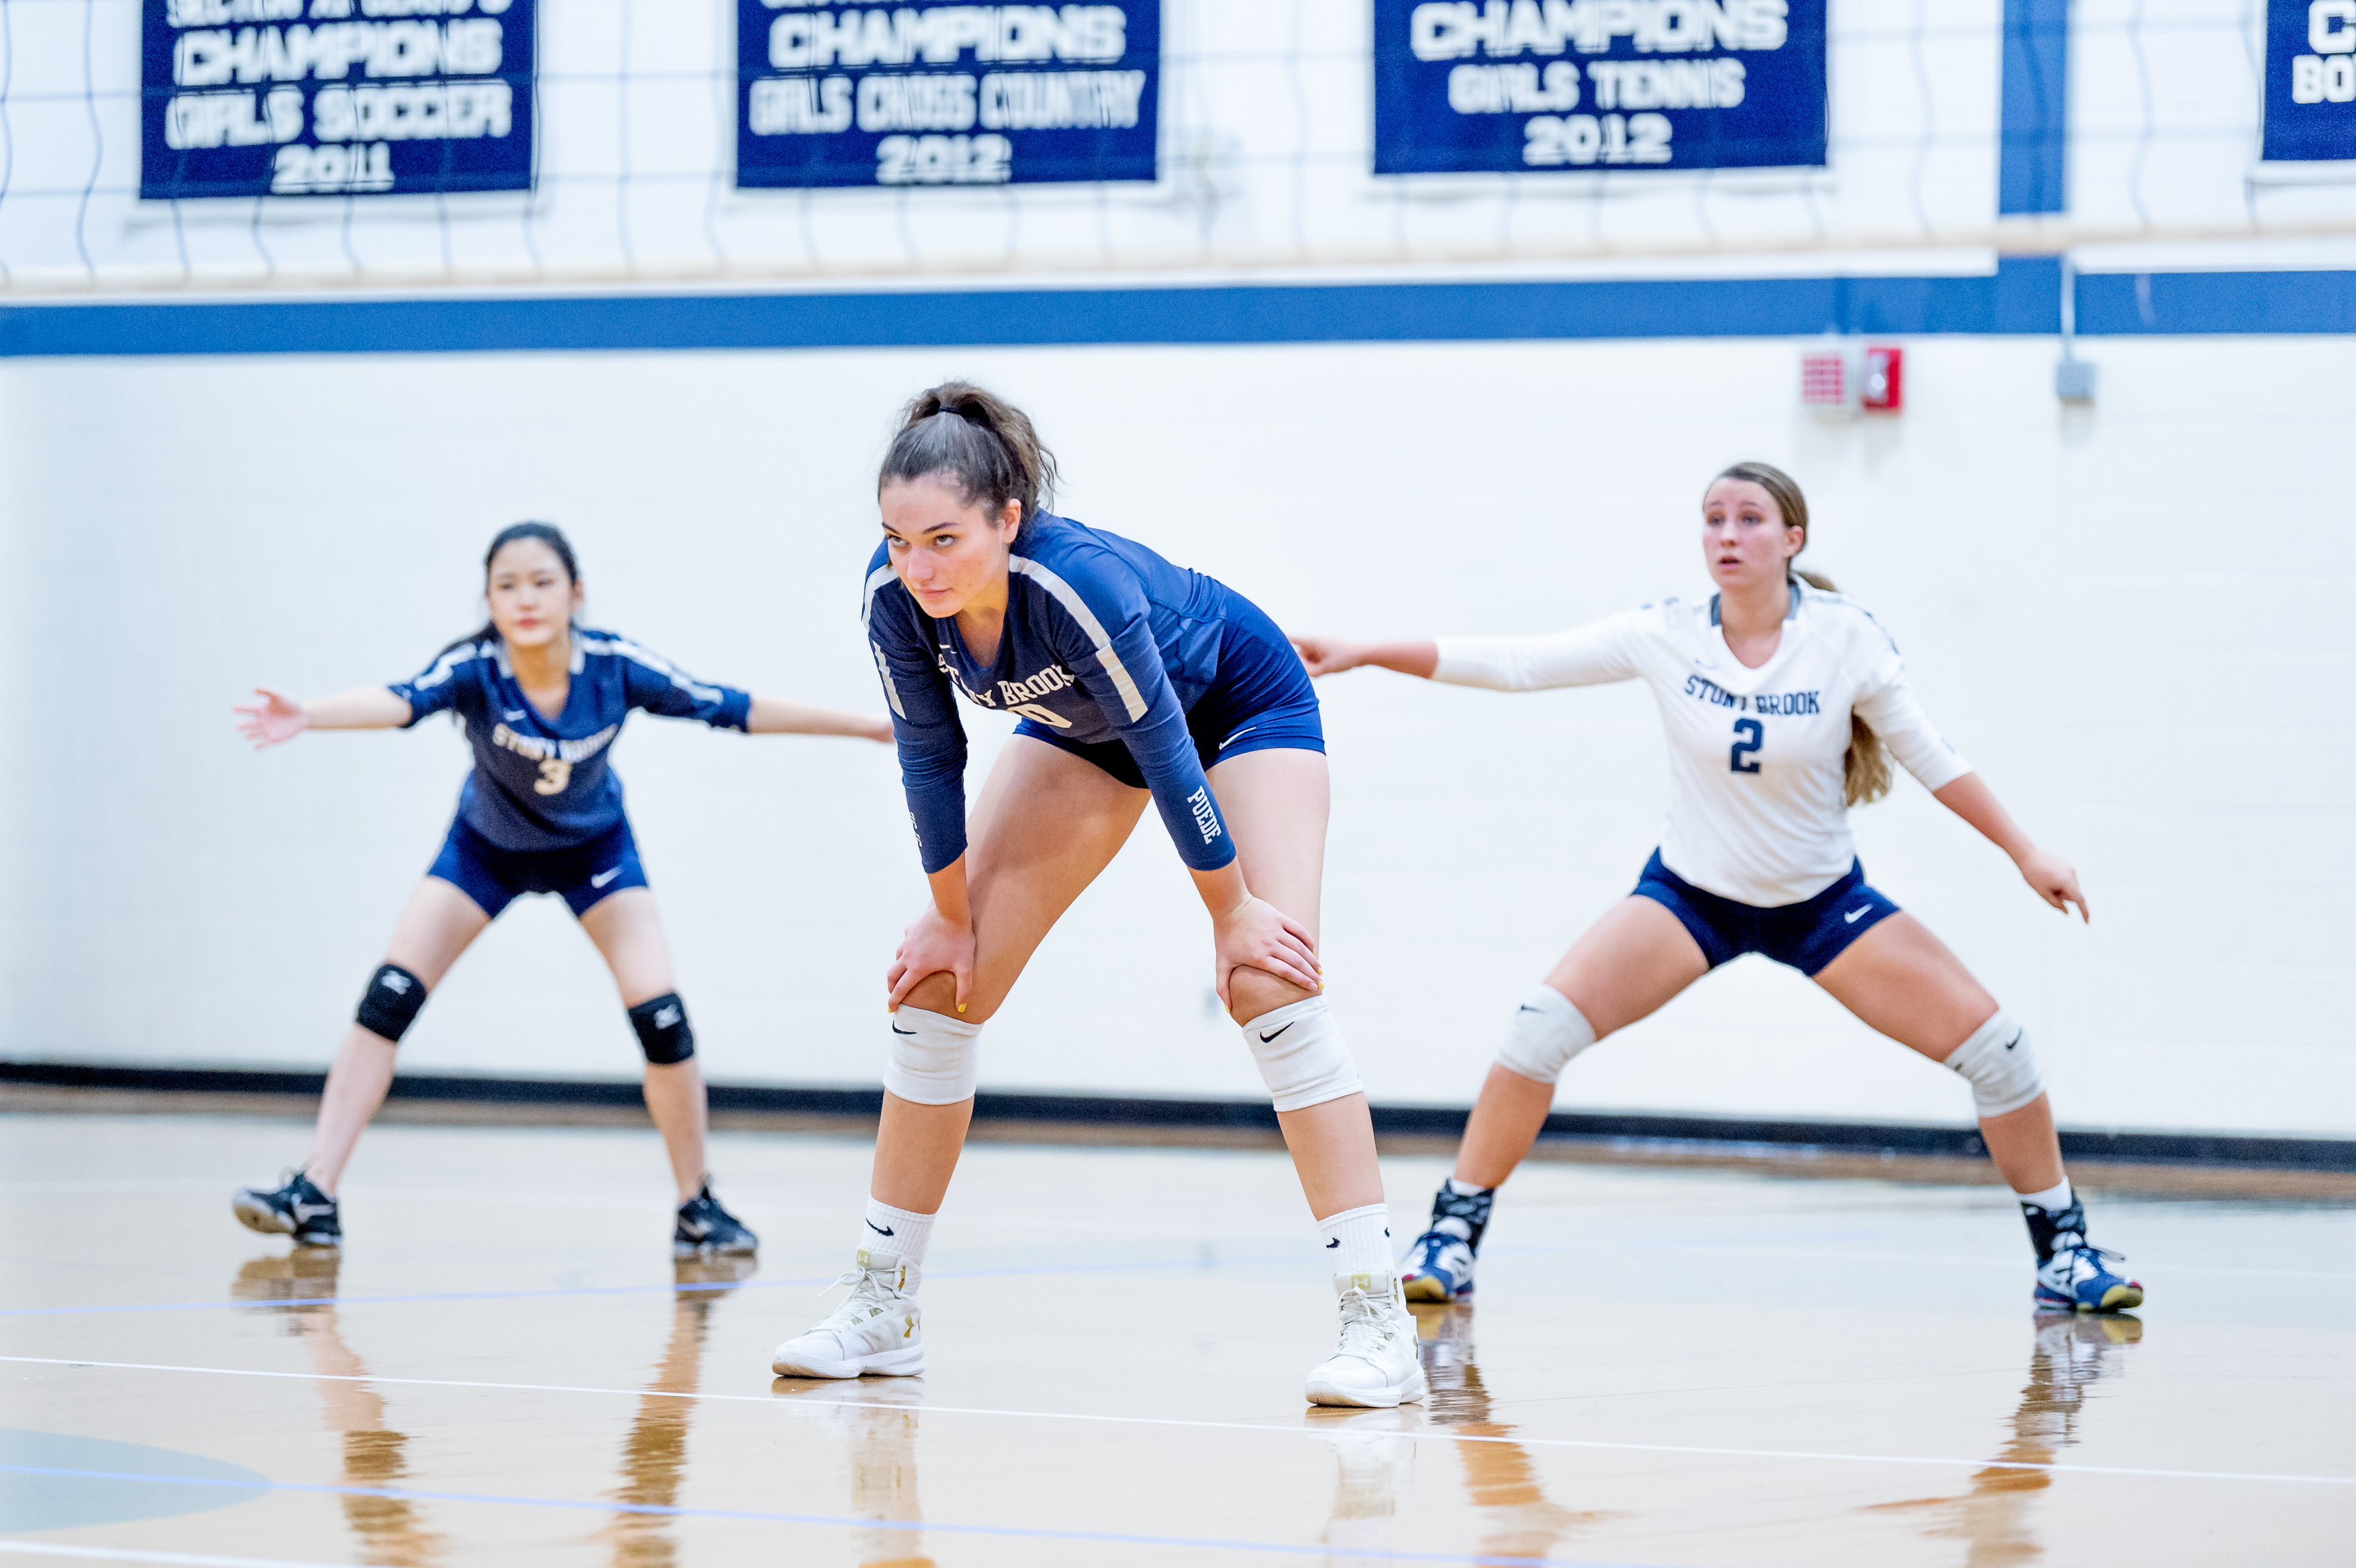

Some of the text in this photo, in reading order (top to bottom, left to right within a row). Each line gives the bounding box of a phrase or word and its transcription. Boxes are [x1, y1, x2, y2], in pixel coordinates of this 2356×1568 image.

[173, 18, 503, 86] CHAMPIONS
[769, 5, 1126, 69] CHAMPIONS
[1411, 0, 1788, 60] CHAMPIONS
[750, 74, 853, 135] GIRLS
[1449, 58, 1746, 113] GIRLS TENNIS
[166, 80, 511, 150] GIRLS SOCCER
[1523, 114, 1672, 165] 2012
[271, 141, 394, 194] 2011
[876, 135, 1012, 184] 2012
[997, 663, 1075, 705] BROOK
[1755, 691, 1820, 714] BROOK
[1731, 717, 1764, 774] 2
[534, 756, 572, 795] 3
[1187, 785, 1222, 845] PUEDE
